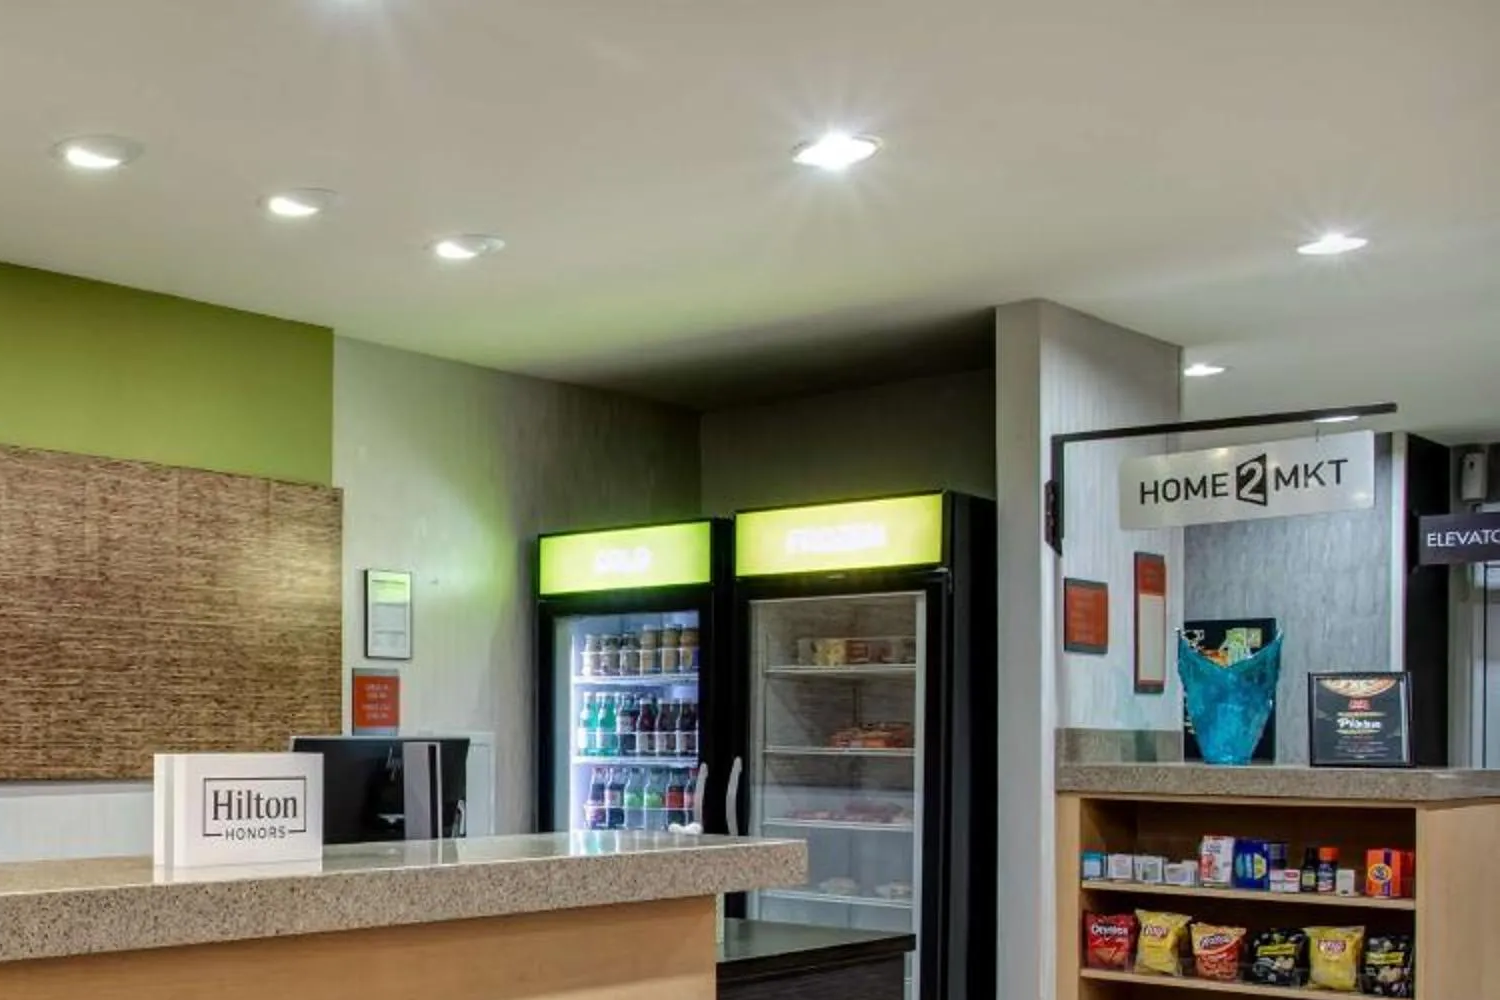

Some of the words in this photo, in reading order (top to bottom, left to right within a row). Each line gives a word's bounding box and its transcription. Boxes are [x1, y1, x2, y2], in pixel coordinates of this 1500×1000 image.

[1274, 459, 1349, 491] MKT
[211, 790, 298, 820] Hilton
[225, 826, 287, 841] HONORS
